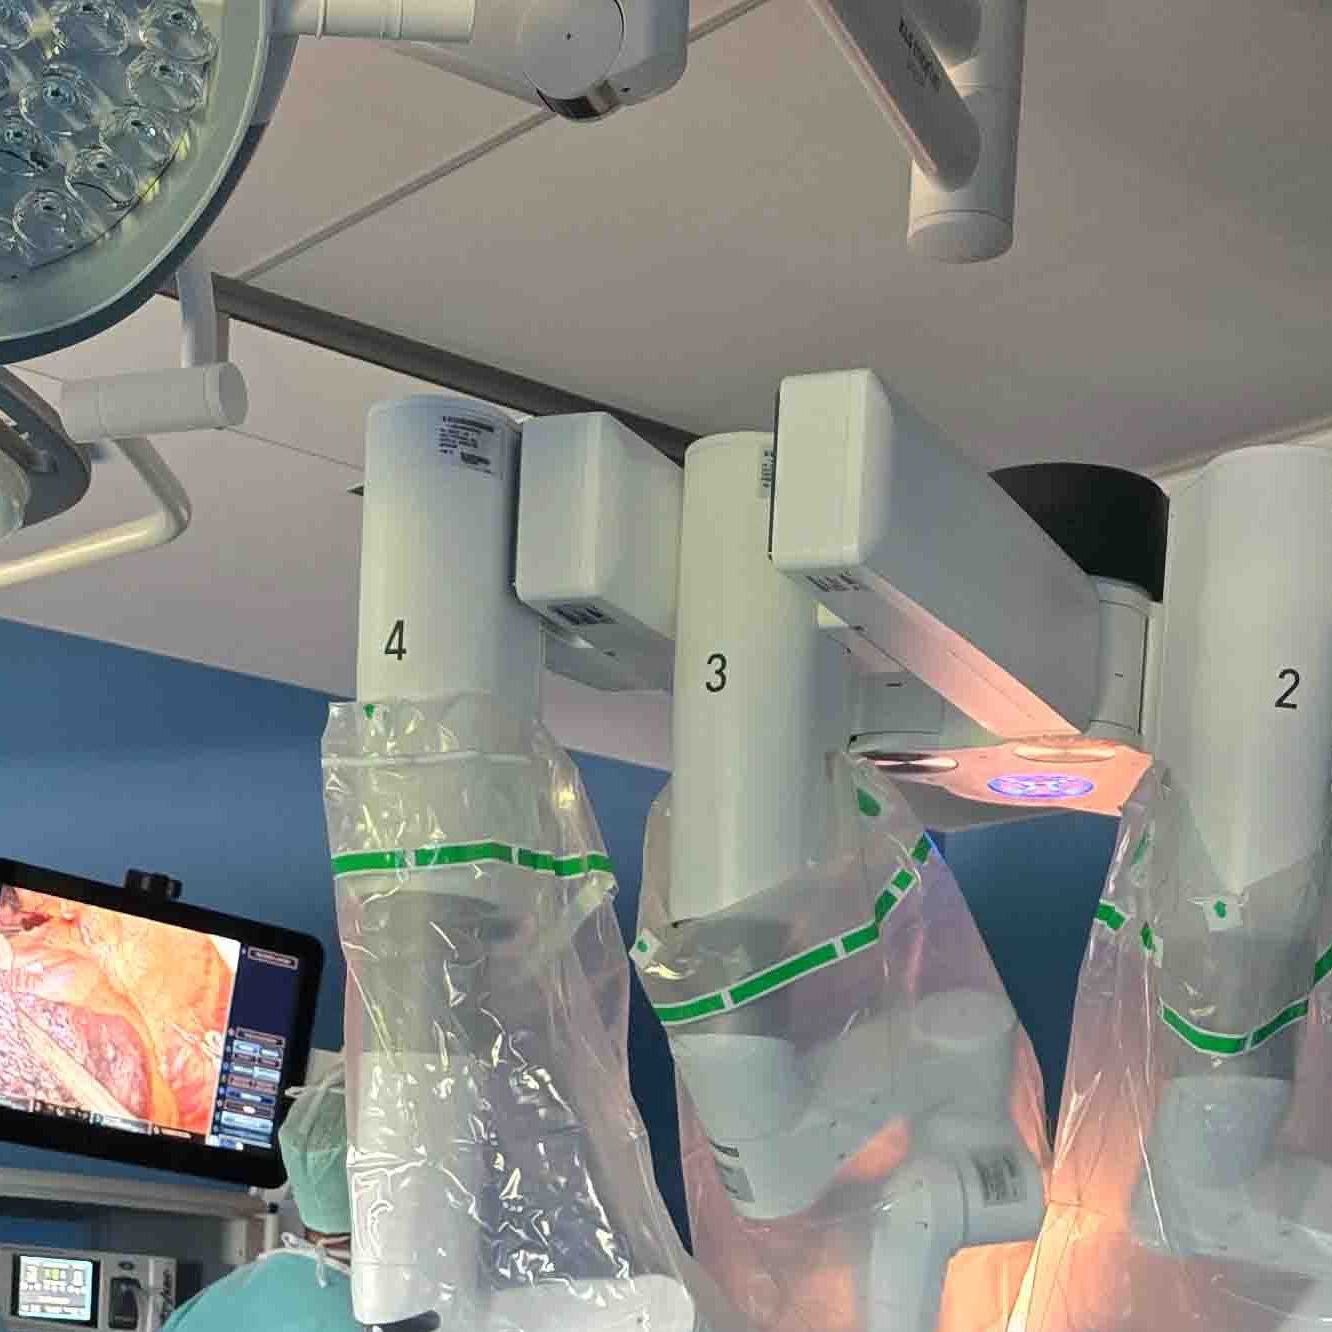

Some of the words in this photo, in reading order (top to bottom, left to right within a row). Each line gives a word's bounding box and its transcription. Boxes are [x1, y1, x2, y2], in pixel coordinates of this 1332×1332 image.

[384, 619, 407, 661] 4
[705, 653, 727, 693] 3
[1274, 668, 1300, 710] 2
